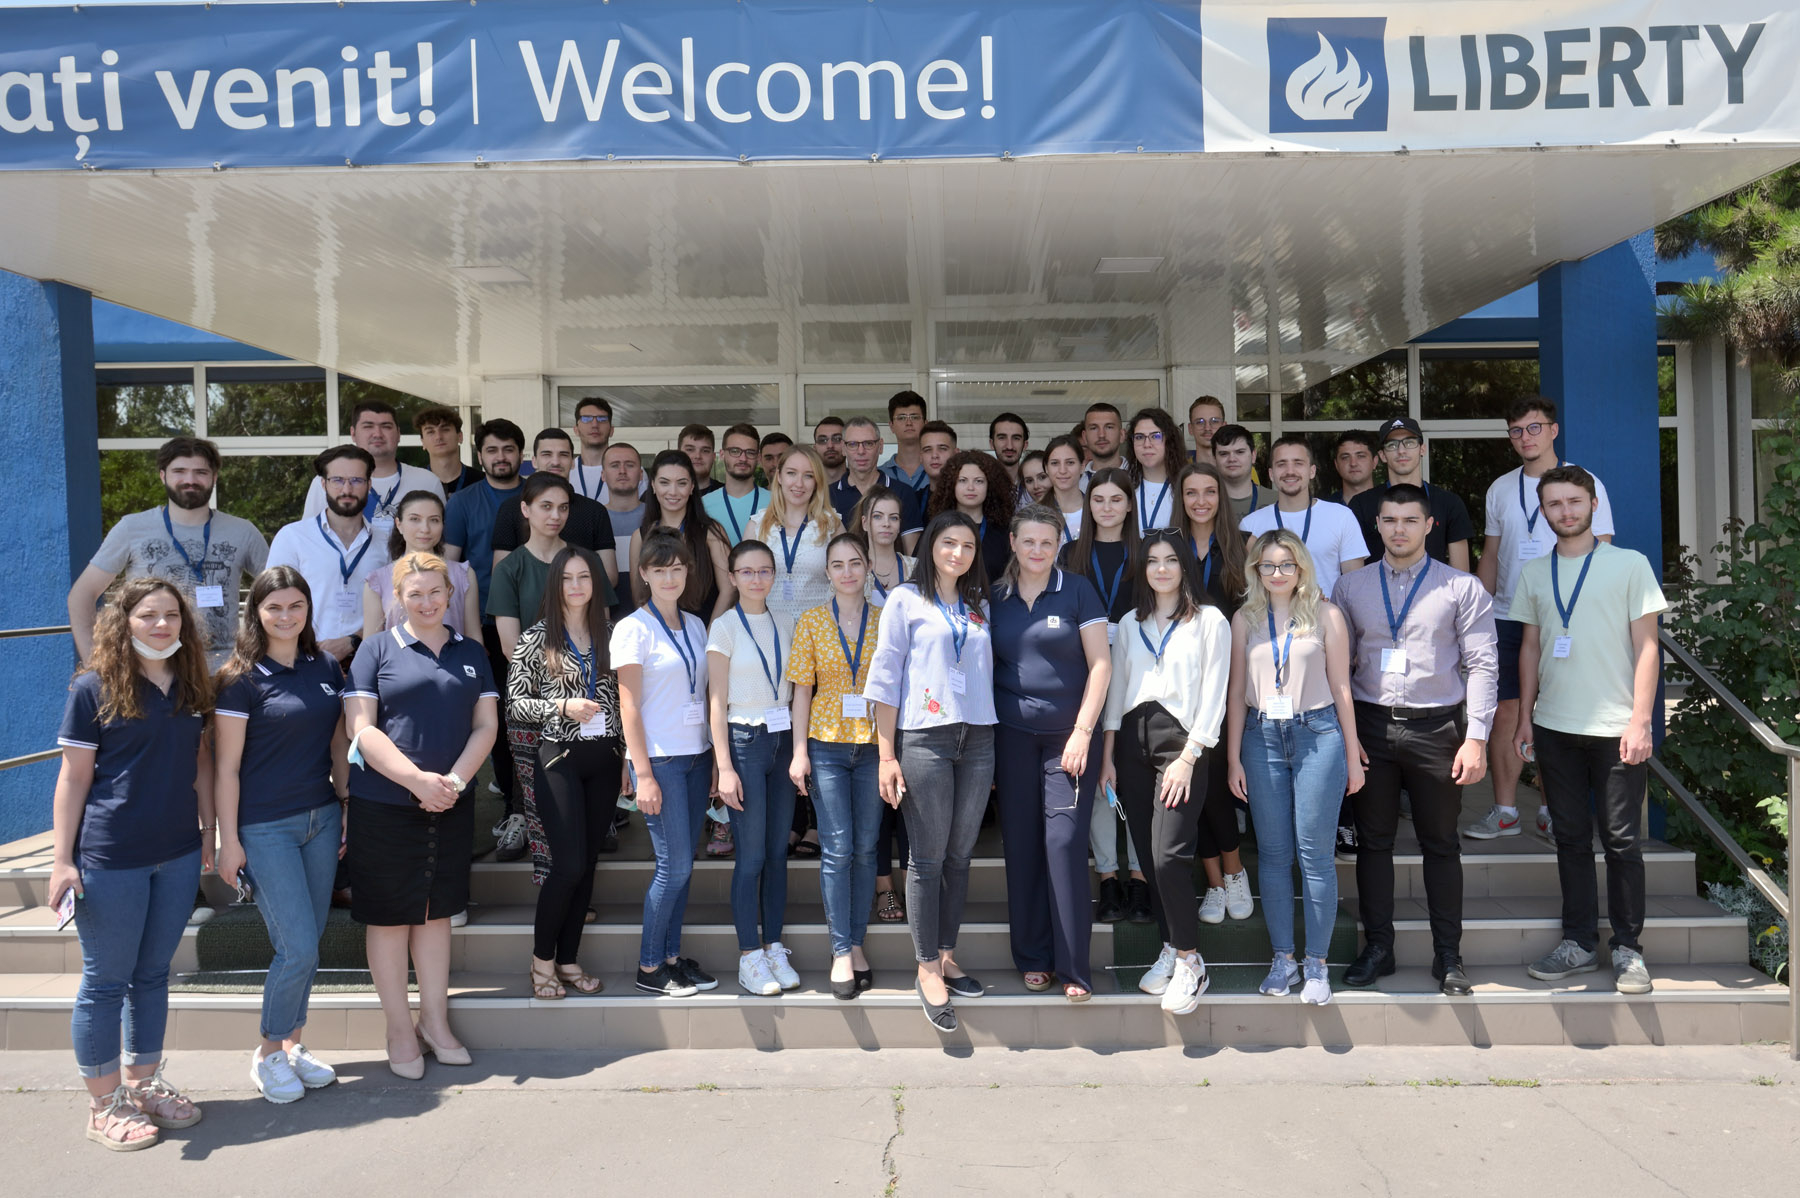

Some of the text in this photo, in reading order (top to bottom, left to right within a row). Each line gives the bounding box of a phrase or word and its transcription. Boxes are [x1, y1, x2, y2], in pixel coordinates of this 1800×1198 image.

[155, 42, 436, 130] venit!
[518, 35, 996, 123] Welcome!
[1409, 23, 1766, 111] LIBERTY
